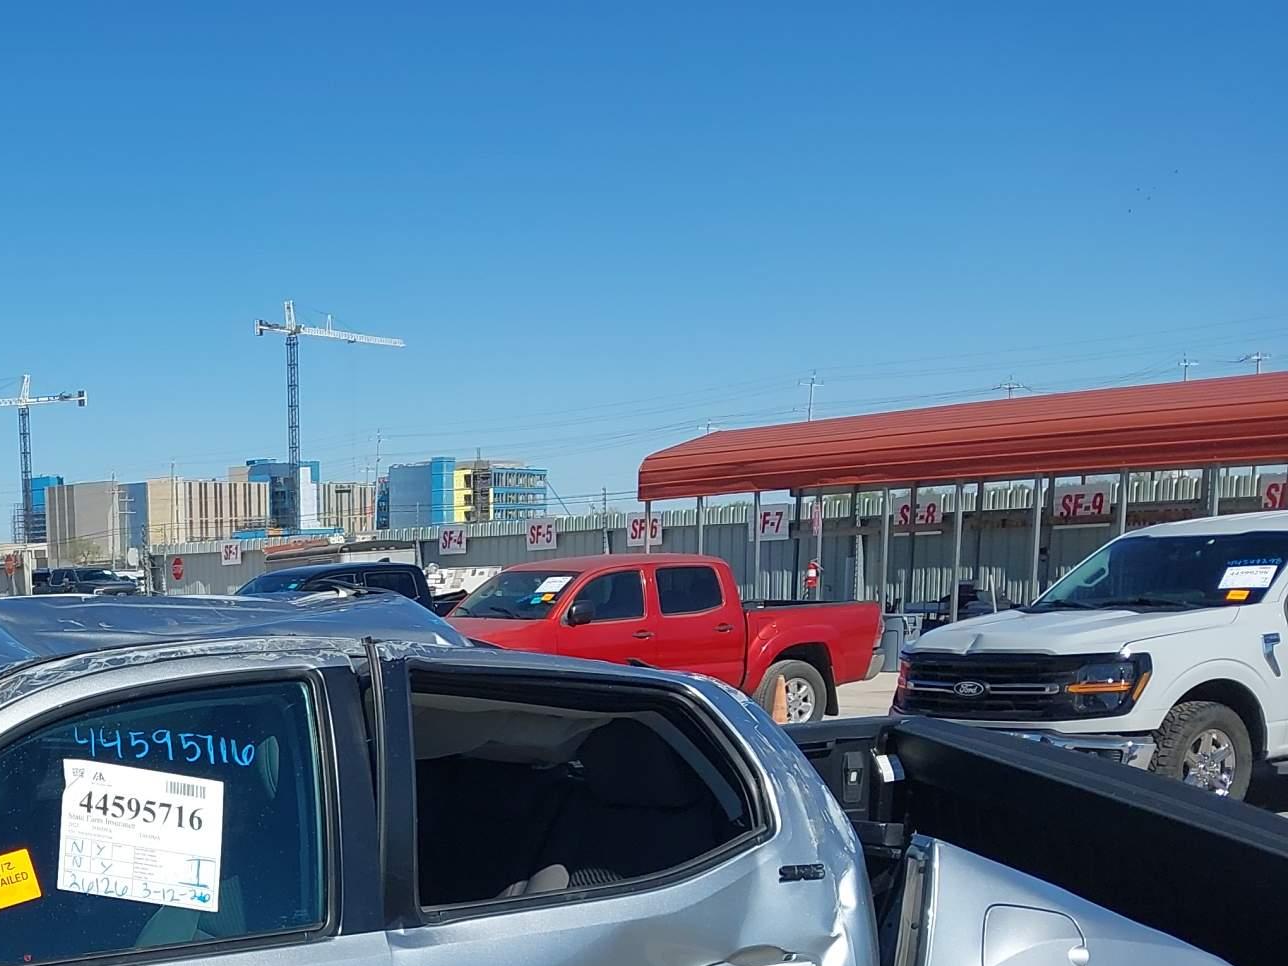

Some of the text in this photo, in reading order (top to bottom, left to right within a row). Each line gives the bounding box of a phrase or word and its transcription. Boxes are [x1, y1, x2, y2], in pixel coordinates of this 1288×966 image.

[899, 502, 937, 526] S-8
[1060, 492, 1105, 518] SF-9
[630, 518, 658, 540] SF6
[756, 511, 784, 534] F-7
[442, 529, 464, 550] SF-4
[529, 524, 553, 545] SF-5
[223, 544, 239, 561] SF-1
[74, 727, 255, 766] 44595716
[79, 790, 205, 832] 44595716
